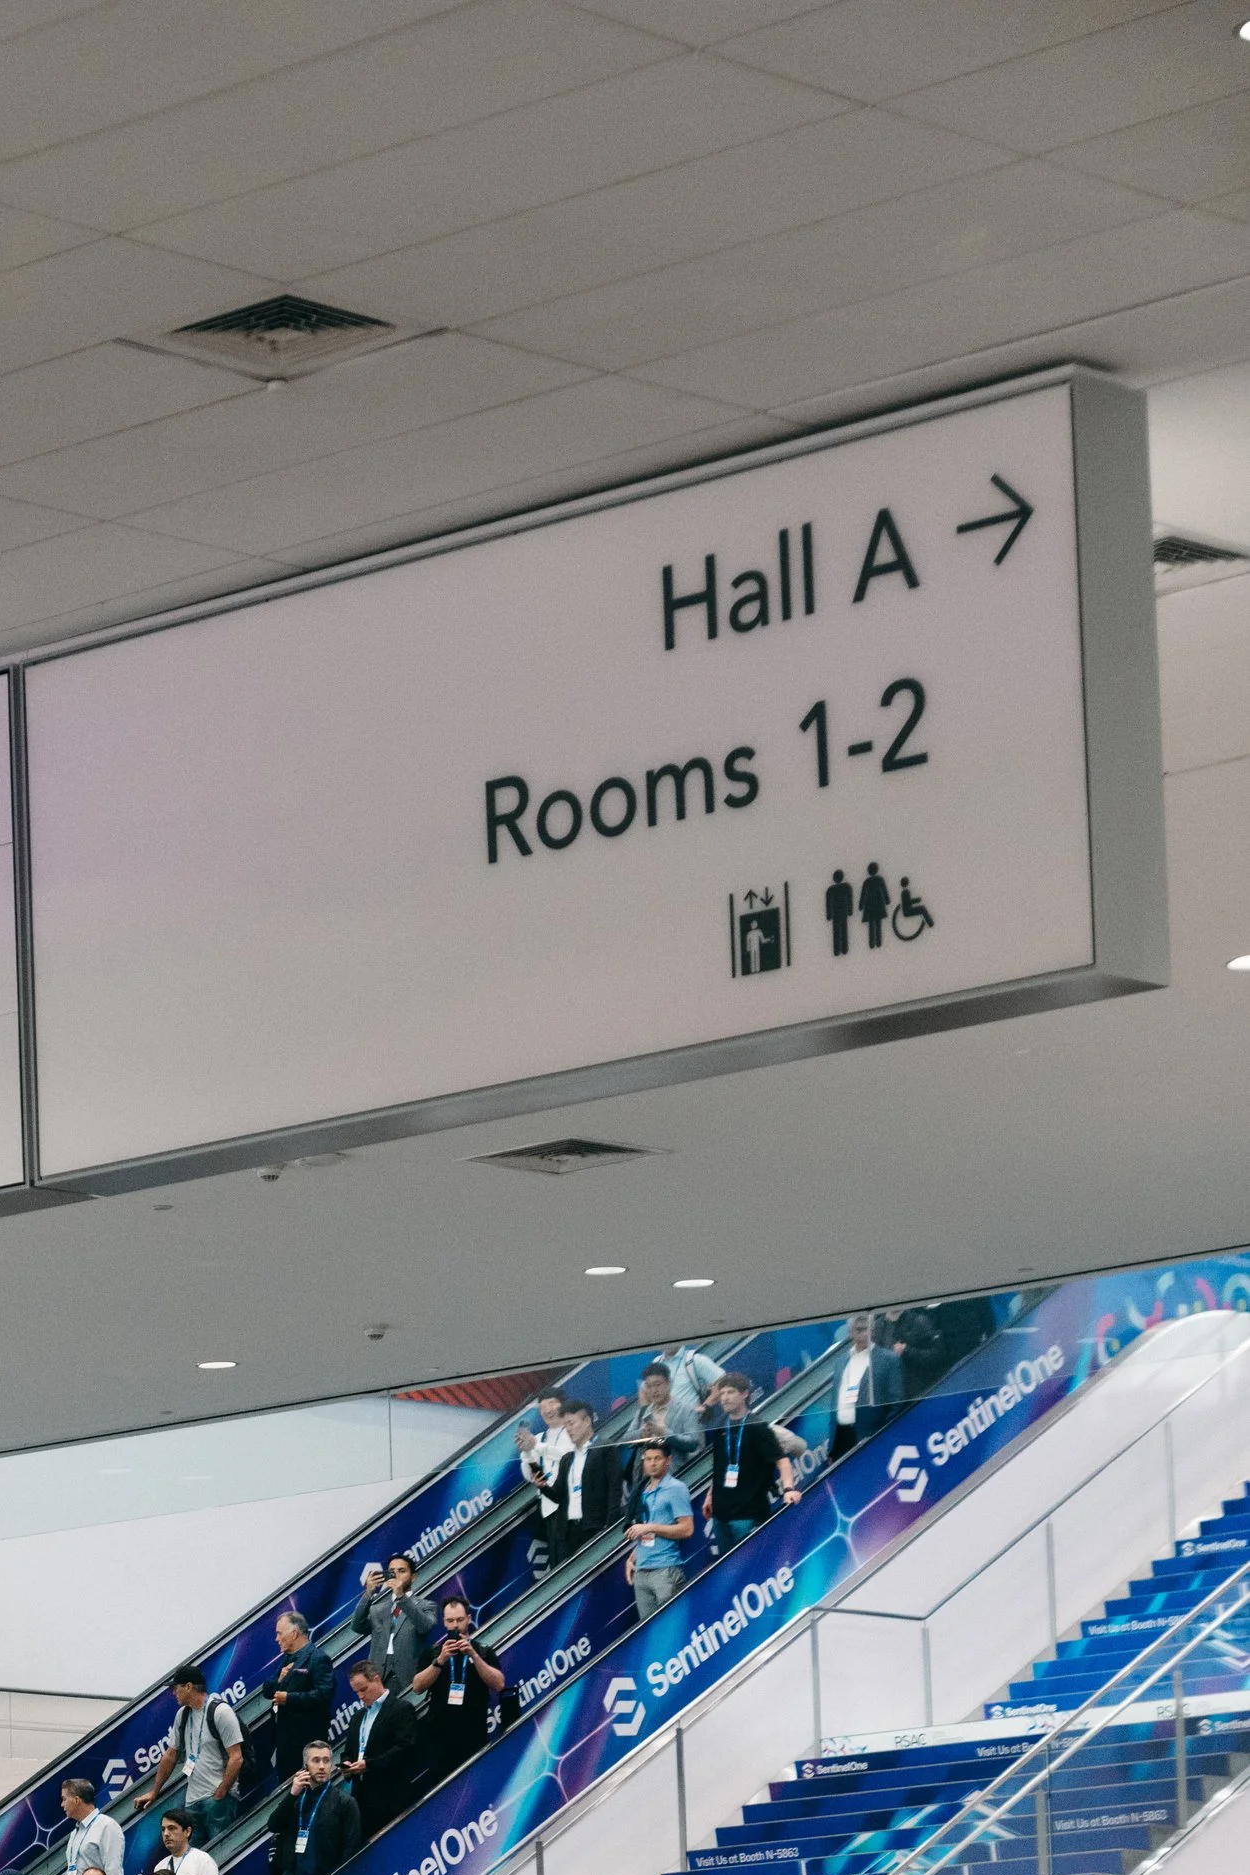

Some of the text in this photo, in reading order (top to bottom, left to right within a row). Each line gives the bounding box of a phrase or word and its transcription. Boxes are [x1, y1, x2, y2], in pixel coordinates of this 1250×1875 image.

[662, 507, 920, 651] Hall A
[484, 677, 928, 864] Rooms 1-2
[927, 1341, 1065, 1466] SentinelOne
[393, 1488, 494, 1563] entinelOne
[646, 1562, 795, 1698] SentinelOne
[1005, 1703, 1057, 1718] SentinelOne
[1157, 1703, 1191, 1719] RSC
[817, 1761, 868, 1775] SentinelOne
[695, 1847, 799, 1867] Visit Us at Booth N-5863
